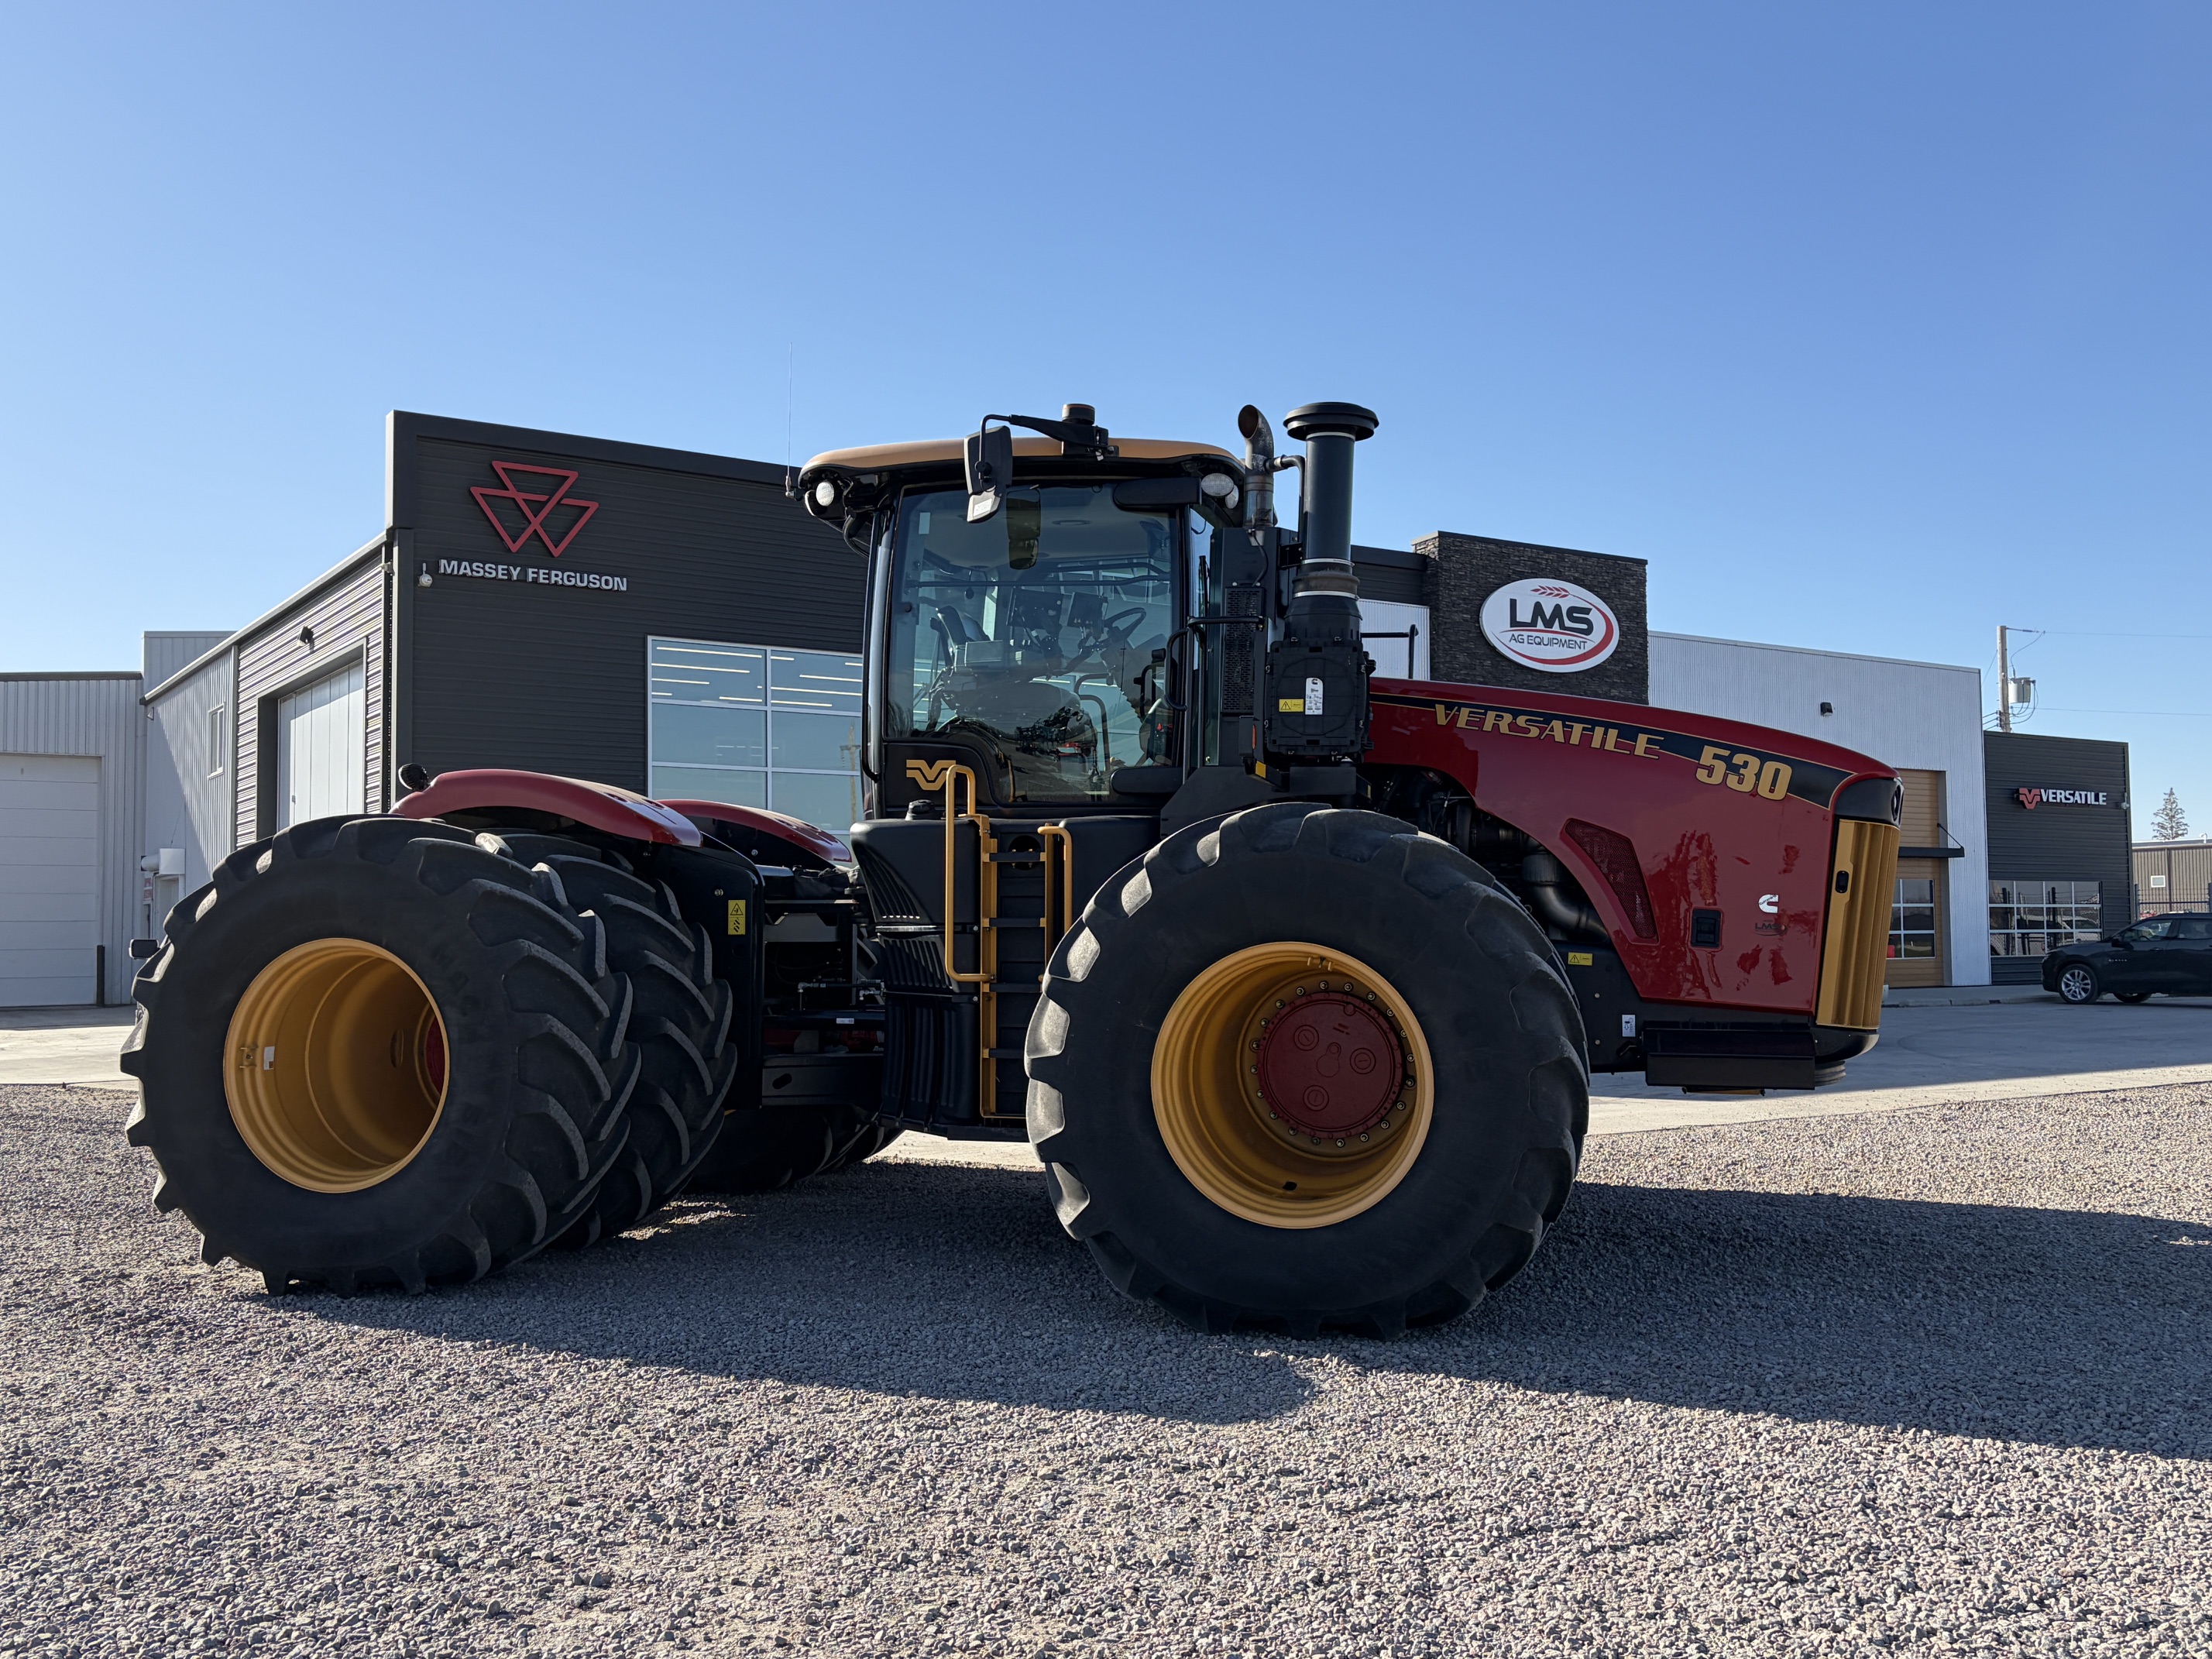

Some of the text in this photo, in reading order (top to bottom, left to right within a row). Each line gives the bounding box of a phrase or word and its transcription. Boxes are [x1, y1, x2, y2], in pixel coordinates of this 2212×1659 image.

[439, 559, 627, 591] MASSEY FERGUSON
[1510, 598, 1594, 636] LMS
[1510, 634, 1588, 650] AG EQUIPMENT
[1435, 704, 1664, 759] VERSATILE
[1695, 745, 1793, 801] 530
[2040, 788, 2107, 805] VERSATILE
